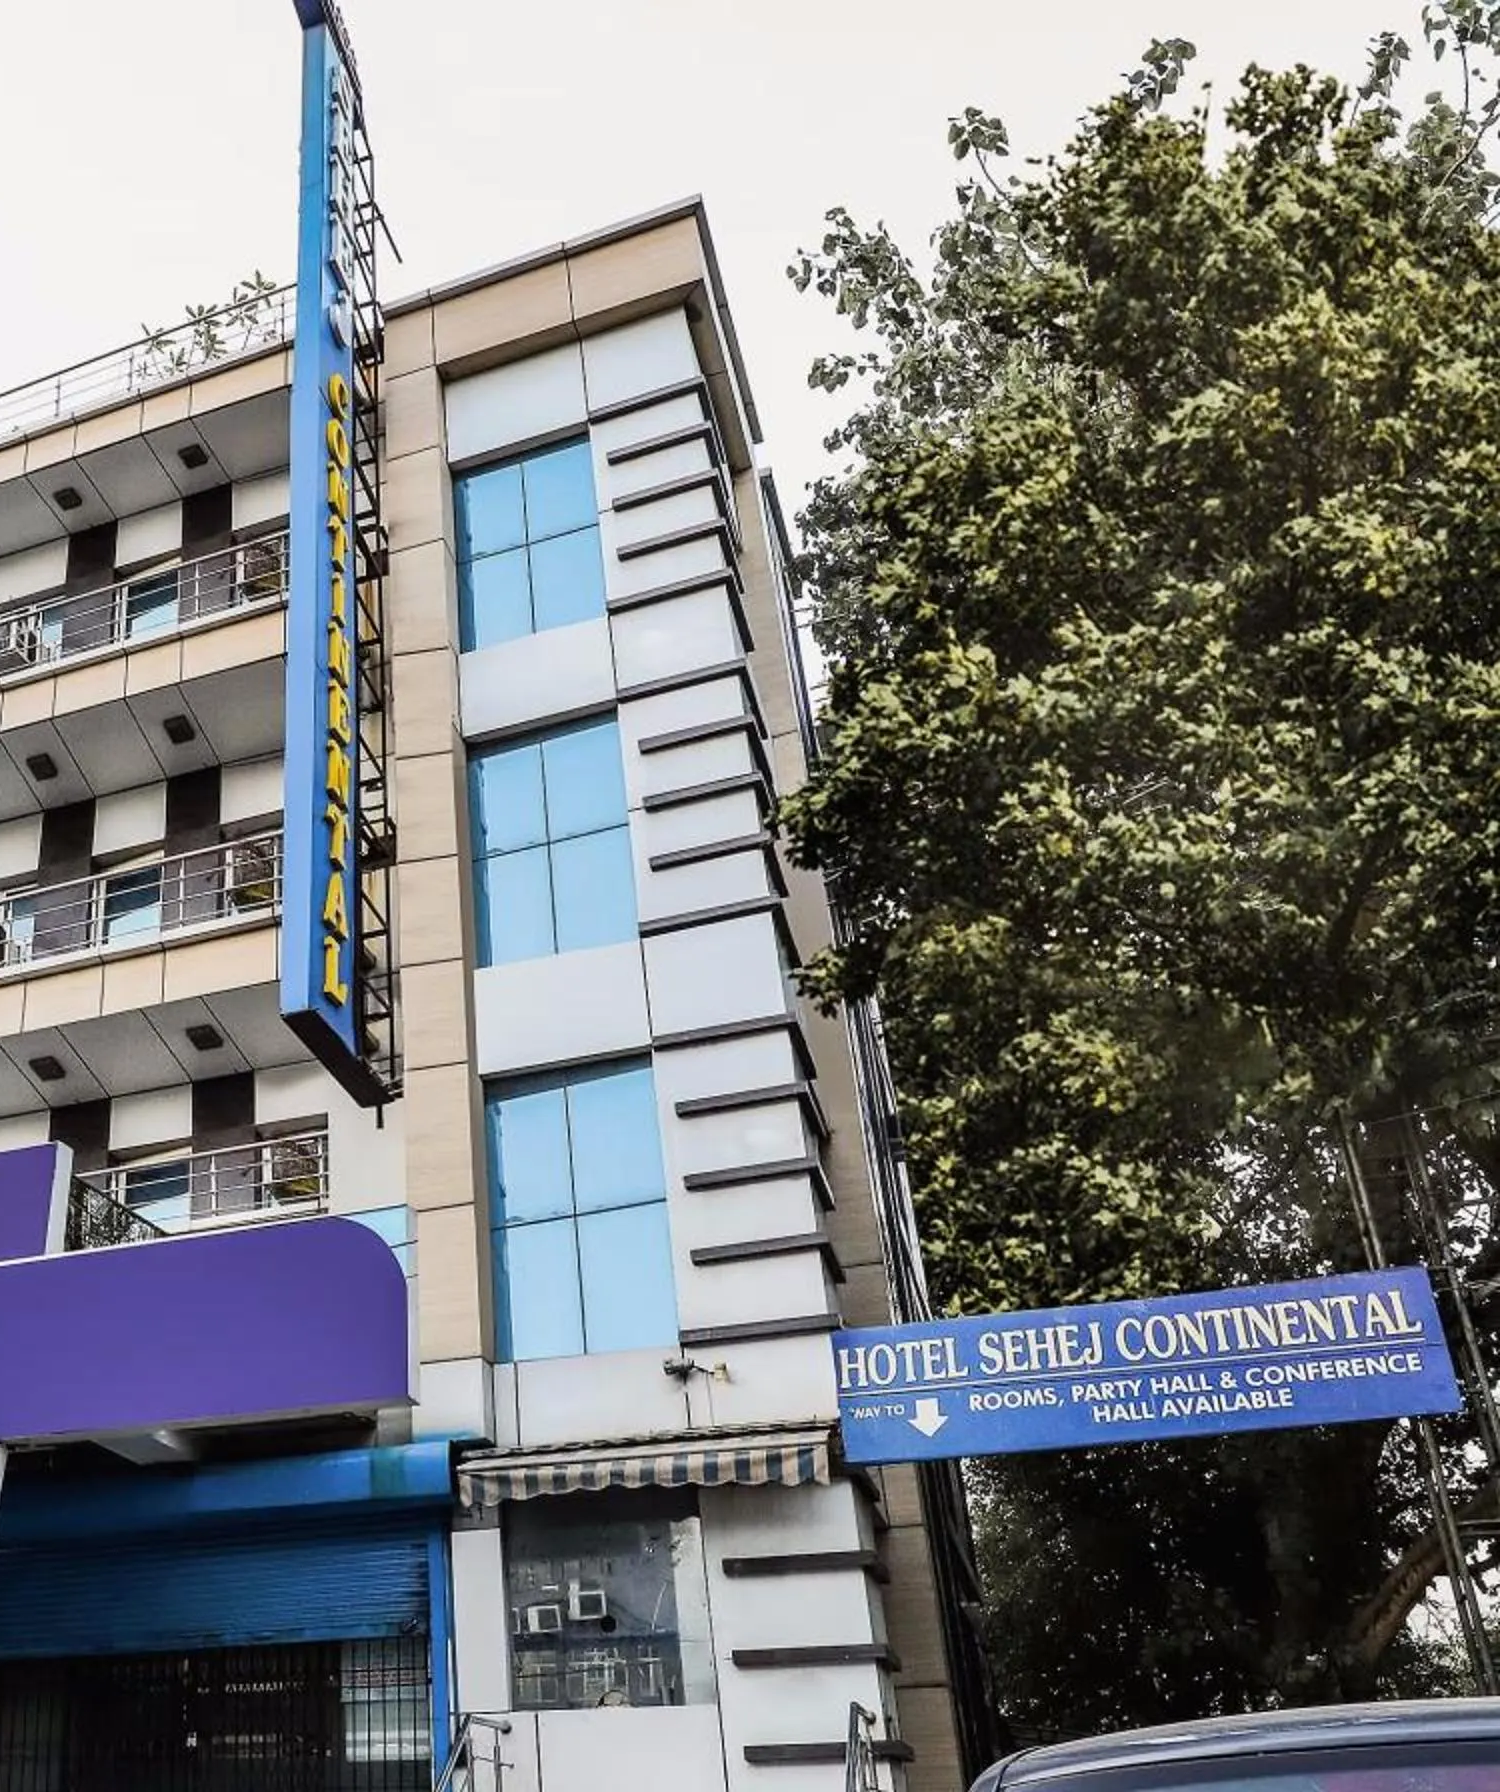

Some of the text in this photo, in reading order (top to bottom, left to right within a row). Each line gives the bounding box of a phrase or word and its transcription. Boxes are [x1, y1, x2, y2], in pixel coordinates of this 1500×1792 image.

[324, 373, 350, 1008] CONTINENTAL
[839, 1289, 1423, 1389] HOTEL SEHEJ CONTINENTAL
[884, 1404, 905, 1416] TO
[968, 1353, 1423, 1411] ROOMS, PARTY HALL & CONFERENCE
[1094, 1388, 1294, 1423] HALL AVAILABLE
